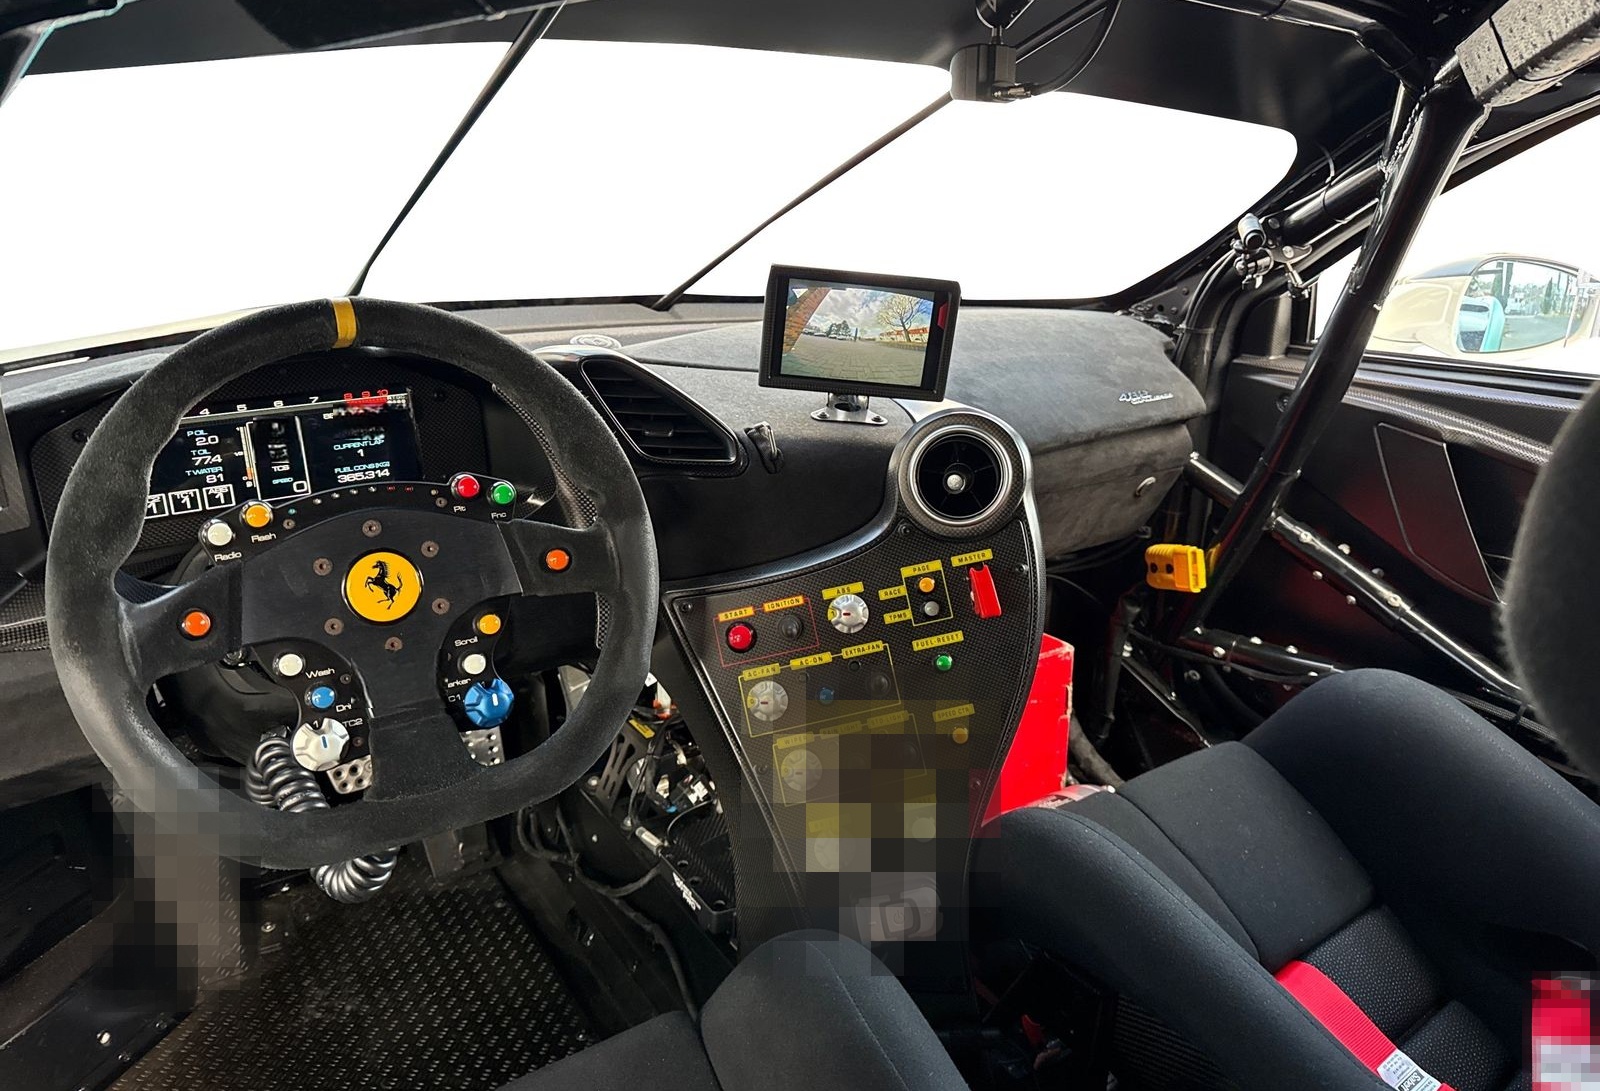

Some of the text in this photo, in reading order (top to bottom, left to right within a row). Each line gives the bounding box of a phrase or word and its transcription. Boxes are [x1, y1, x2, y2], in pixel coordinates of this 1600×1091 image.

[236, 404, 247, 412] 5
[309, 396, 319, 404] 7
[376, 389, 389, 397] 10
[333, 438, 385, 450] CURRENT LAP
[357, 449, 364, 457] 1
[191, 454, 223, 466] 77.4
[191, 466, 224, 475] WATER
[334, 464, 354, 474] FUEL
[206, 473, 224, 484] 81
[337, 469, 390, 483] 365.314
[208, 486, 228, 495] ABS
[293, 480, 308, 493] 0
[215, 492, 225, 504] 1
[491, 512, 507, 520] Fnc
[251, 532, 277, 543] Flash
[214, 551, 242, 561] Radio
[957, 552, 986, 563] MASTER
[912, 564, 930, 573] PAGE
[836, 586, 851, 595] ABS
[884, 588, 901, 597] RACE
[767, 599, 801, 610] IGNITION
[724, 610, 748, 619] START
[889, 612, 907, 621] TPMS
[454, 636, 478, 647] Scroll
[915, 633, 959, 649] FUEL-RESET
[844, 643, 881, 656] EXTRA-FAN
[799, 656, 823, 666] AC-ON
[305, 667, 335, 679] Wash
[747, 667, 776, 678] AC-FAN
[447, 678, 471, 688] arker
[448, 694, 461, 703] C1
[313, 720, 319, 728] 1
[342, 717, 363, 728] TC2
